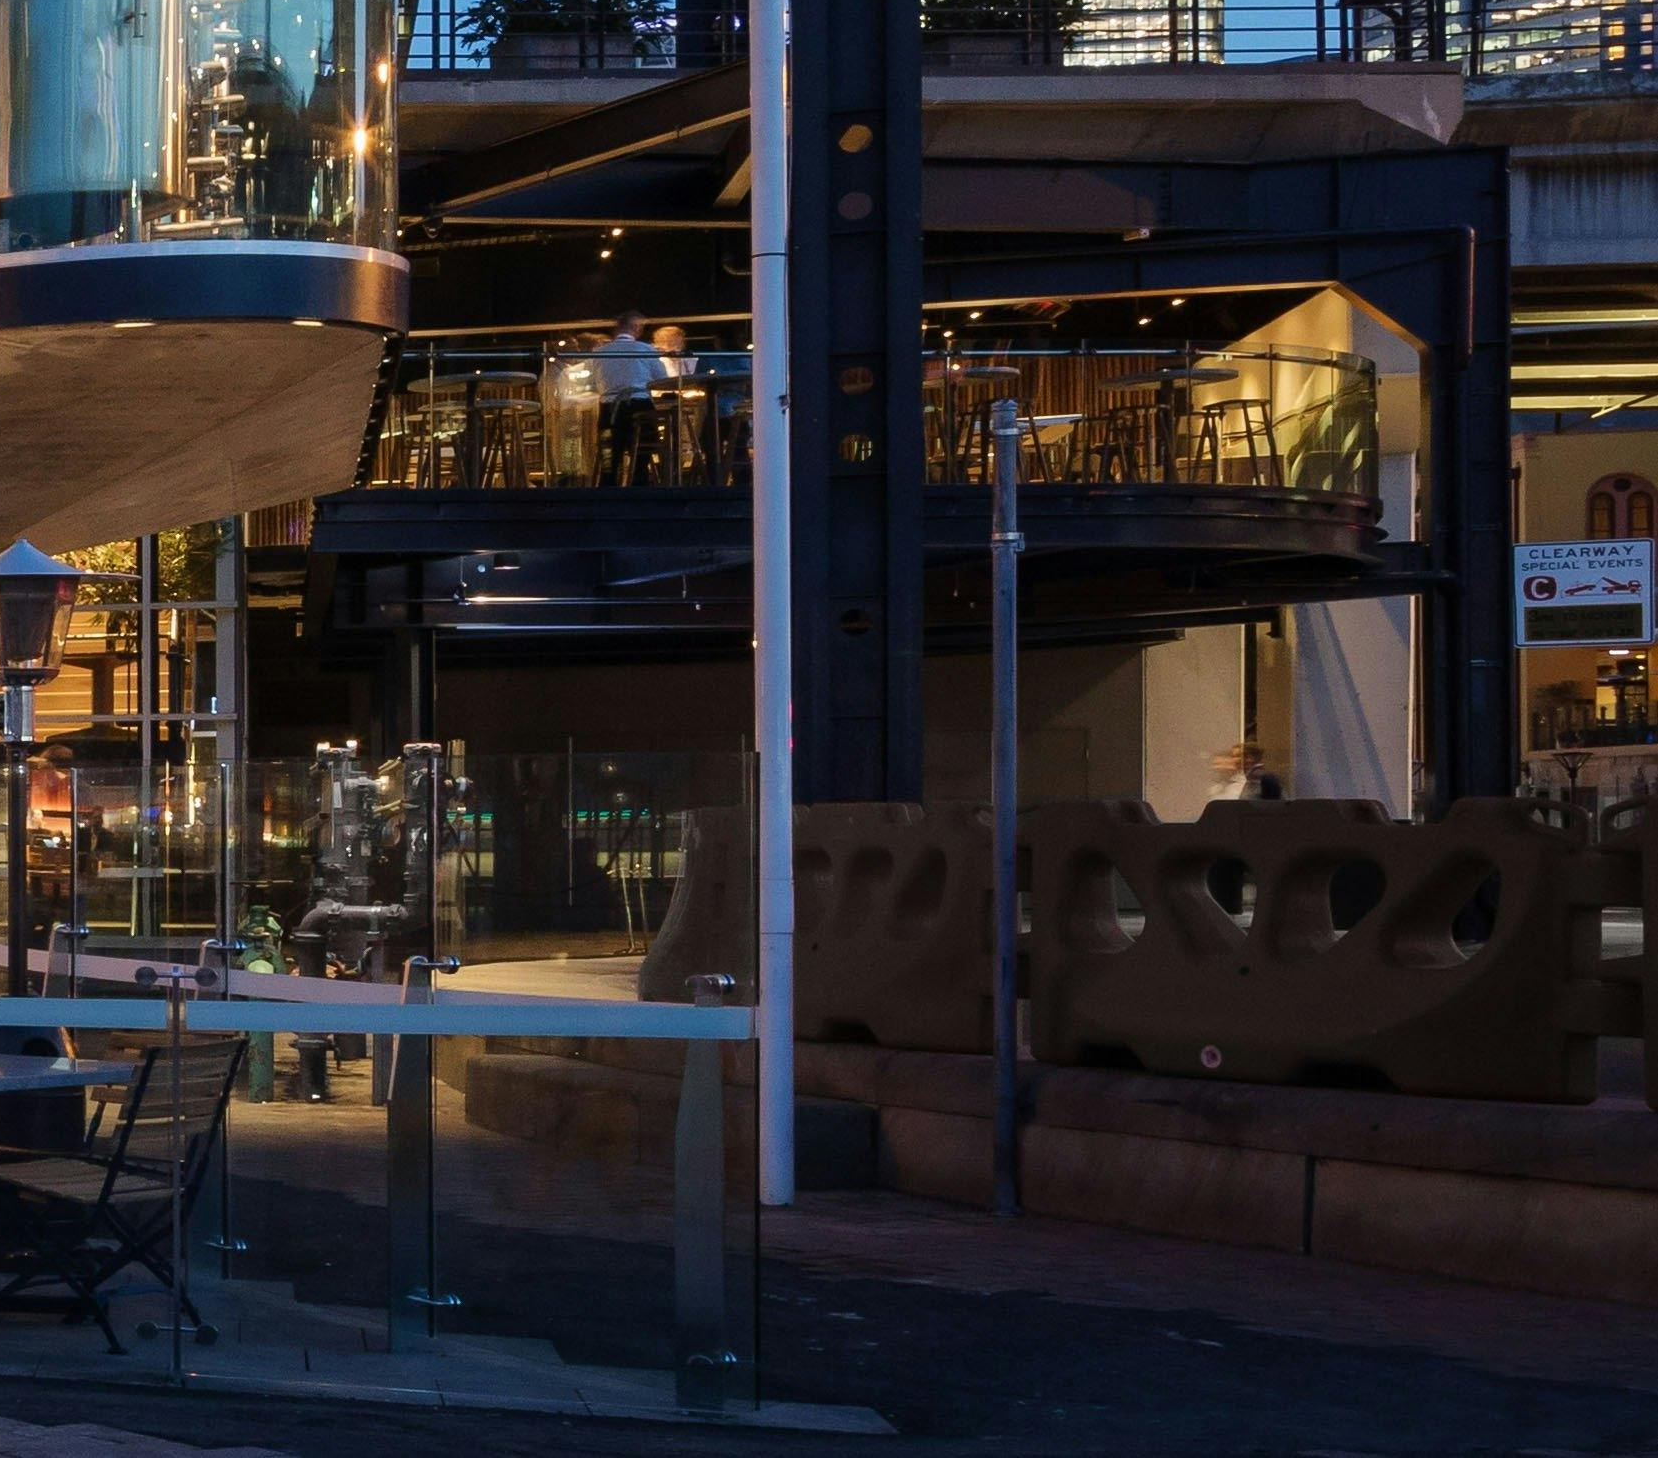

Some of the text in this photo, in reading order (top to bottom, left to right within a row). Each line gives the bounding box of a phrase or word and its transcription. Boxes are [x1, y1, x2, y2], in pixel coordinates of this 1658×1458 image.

[1529, 546, 1634, 559] CLEARWAY
[1521, 559, 1643, 571] SPECIAL EVENTS
[1531, 579, 1550, 598] C
